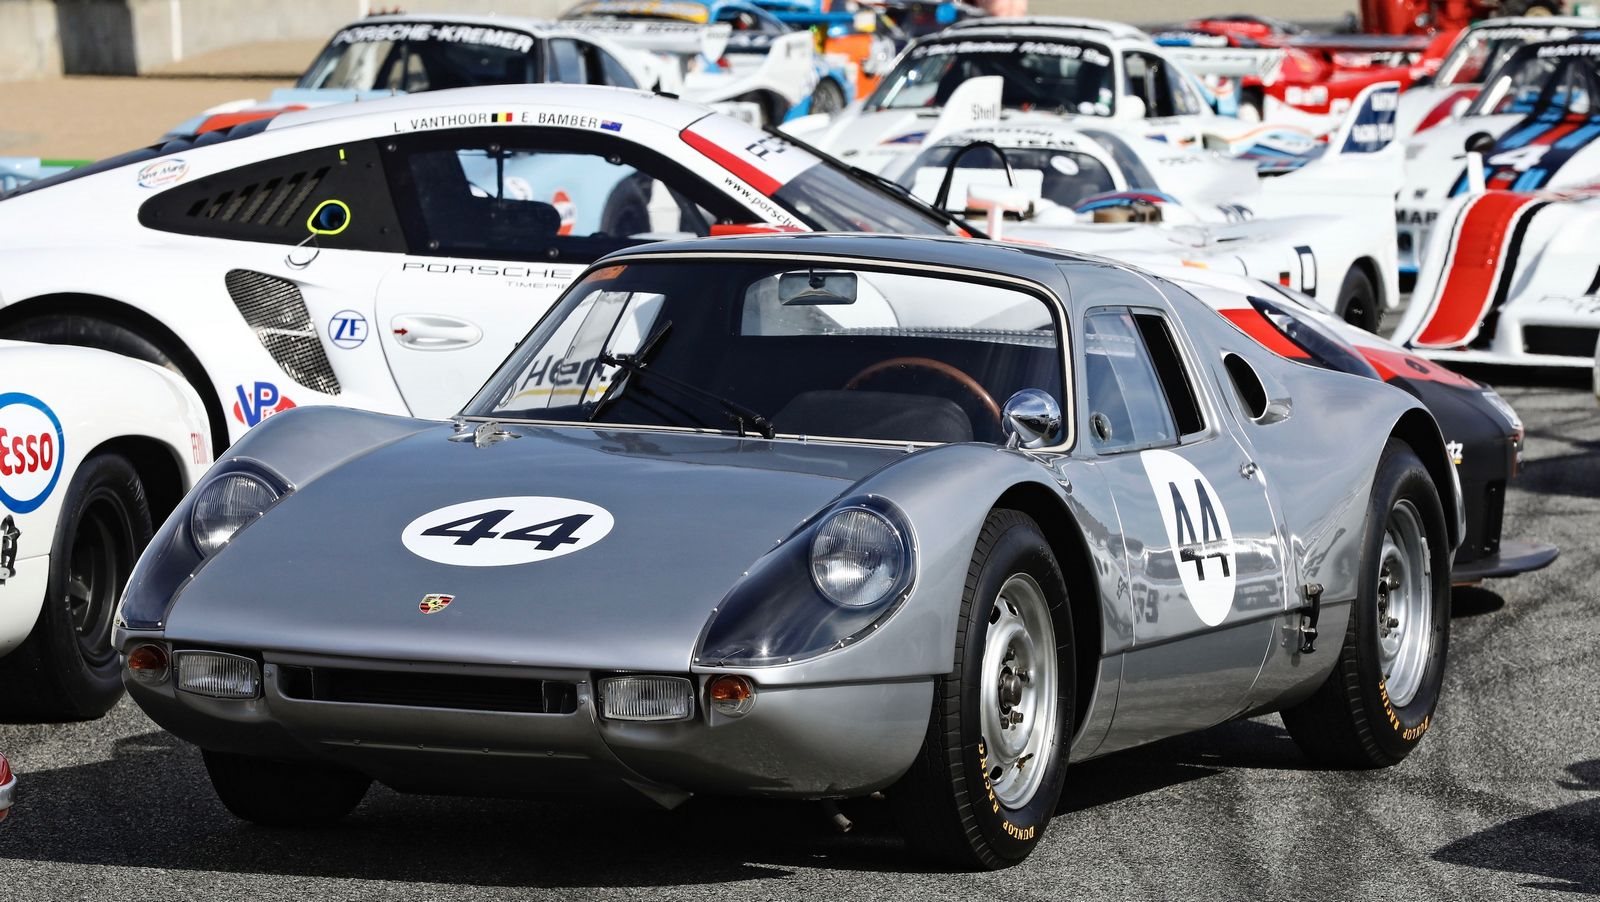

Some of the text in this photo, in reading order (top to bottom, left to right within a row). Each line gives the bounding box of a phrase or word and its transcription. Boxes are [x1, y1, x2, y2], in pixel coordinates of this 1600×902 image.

[394, 111, 598, 133] L. VANTHOOR E. BAMBER
[402, 262, 574, 280] PORSCHE
[332, 318, 366, 342] ZF
[520, 355, 620, 391] Her
[236, 381, 279, 428] VP
[420, 508, 595, 552] 44
[1168, 478, 1231, 581] 44
[977, 743, 1035, 841] DUNLOP RACING
